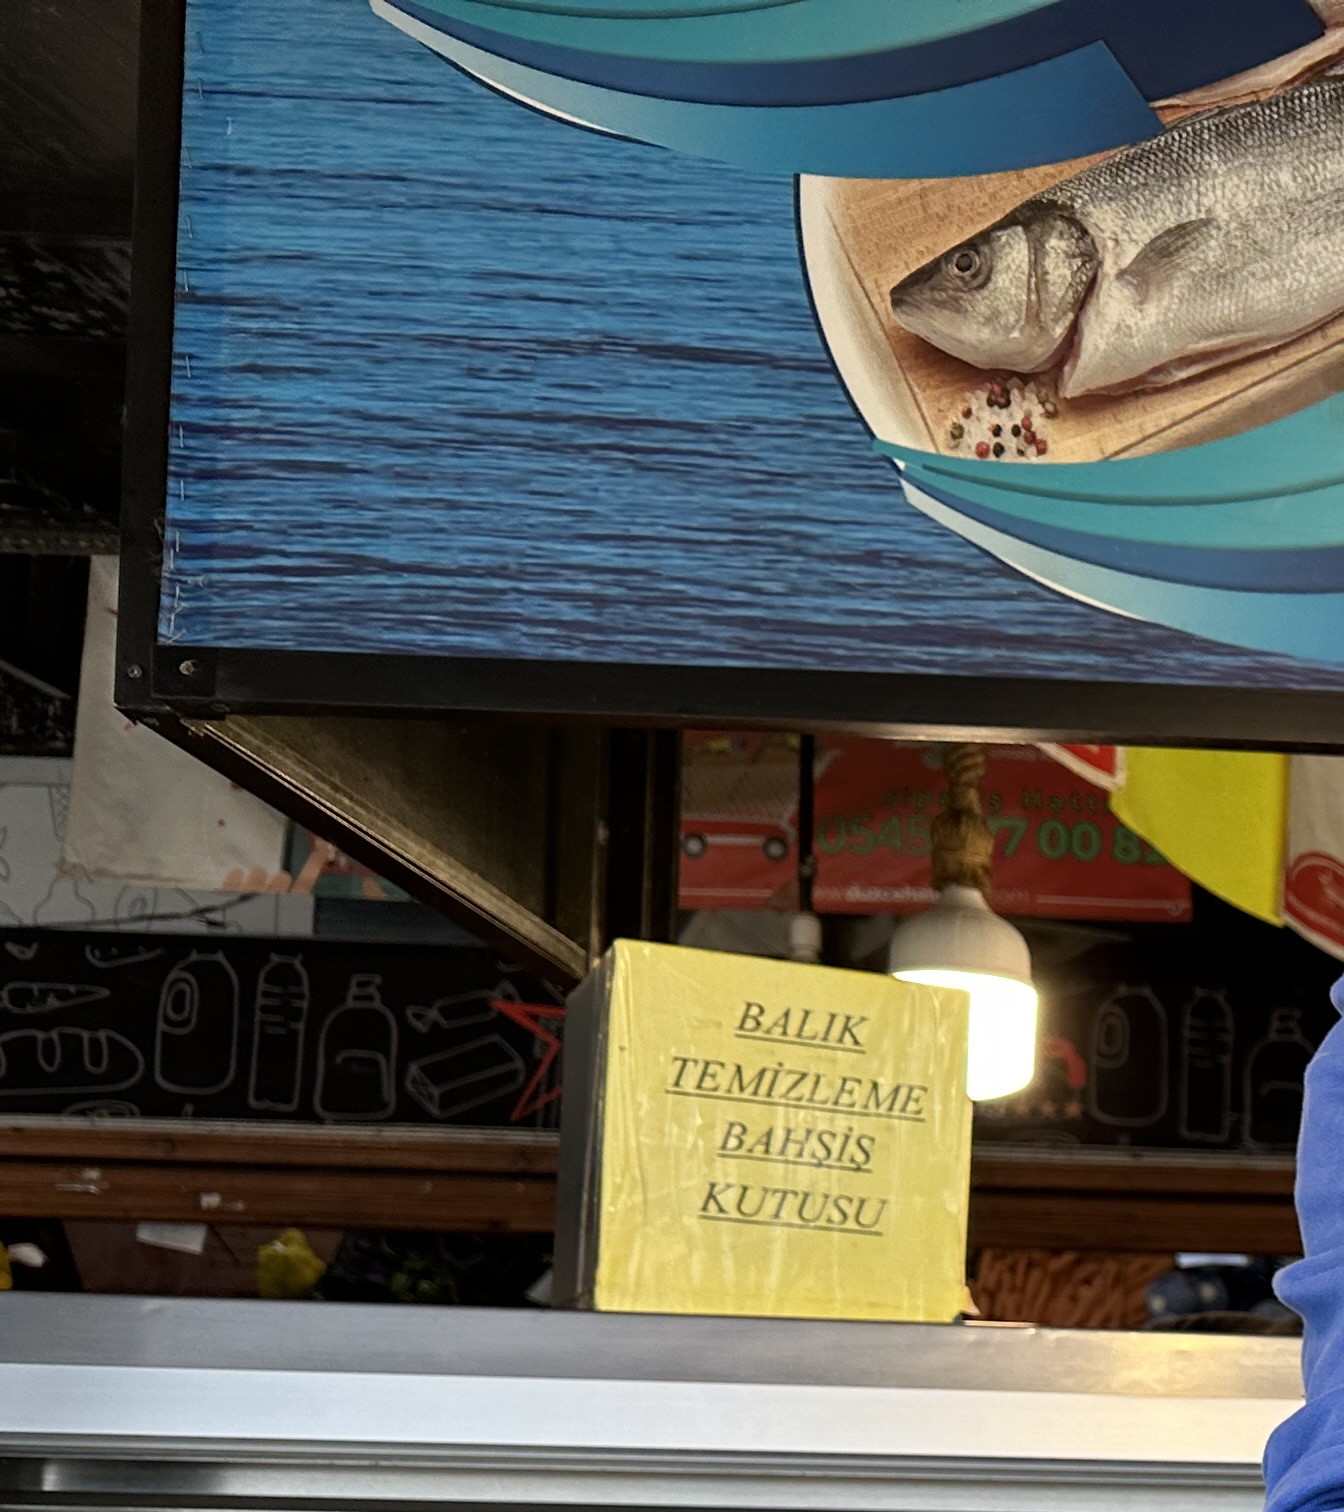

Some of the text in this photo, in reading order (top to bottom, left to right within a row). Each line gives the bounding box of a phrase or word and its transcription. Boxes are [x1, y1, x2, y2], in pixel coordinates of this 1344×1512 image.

[1037, 817, 1102, 862] 00
[735, 1001, 869, 1048] BALIK
[671, 1054, 928, 1117] TEMİZLEME
[719, 1121, 875, 1171] BAHŞİŞ
[700, 1180, 887, 1230] KUTUSU
